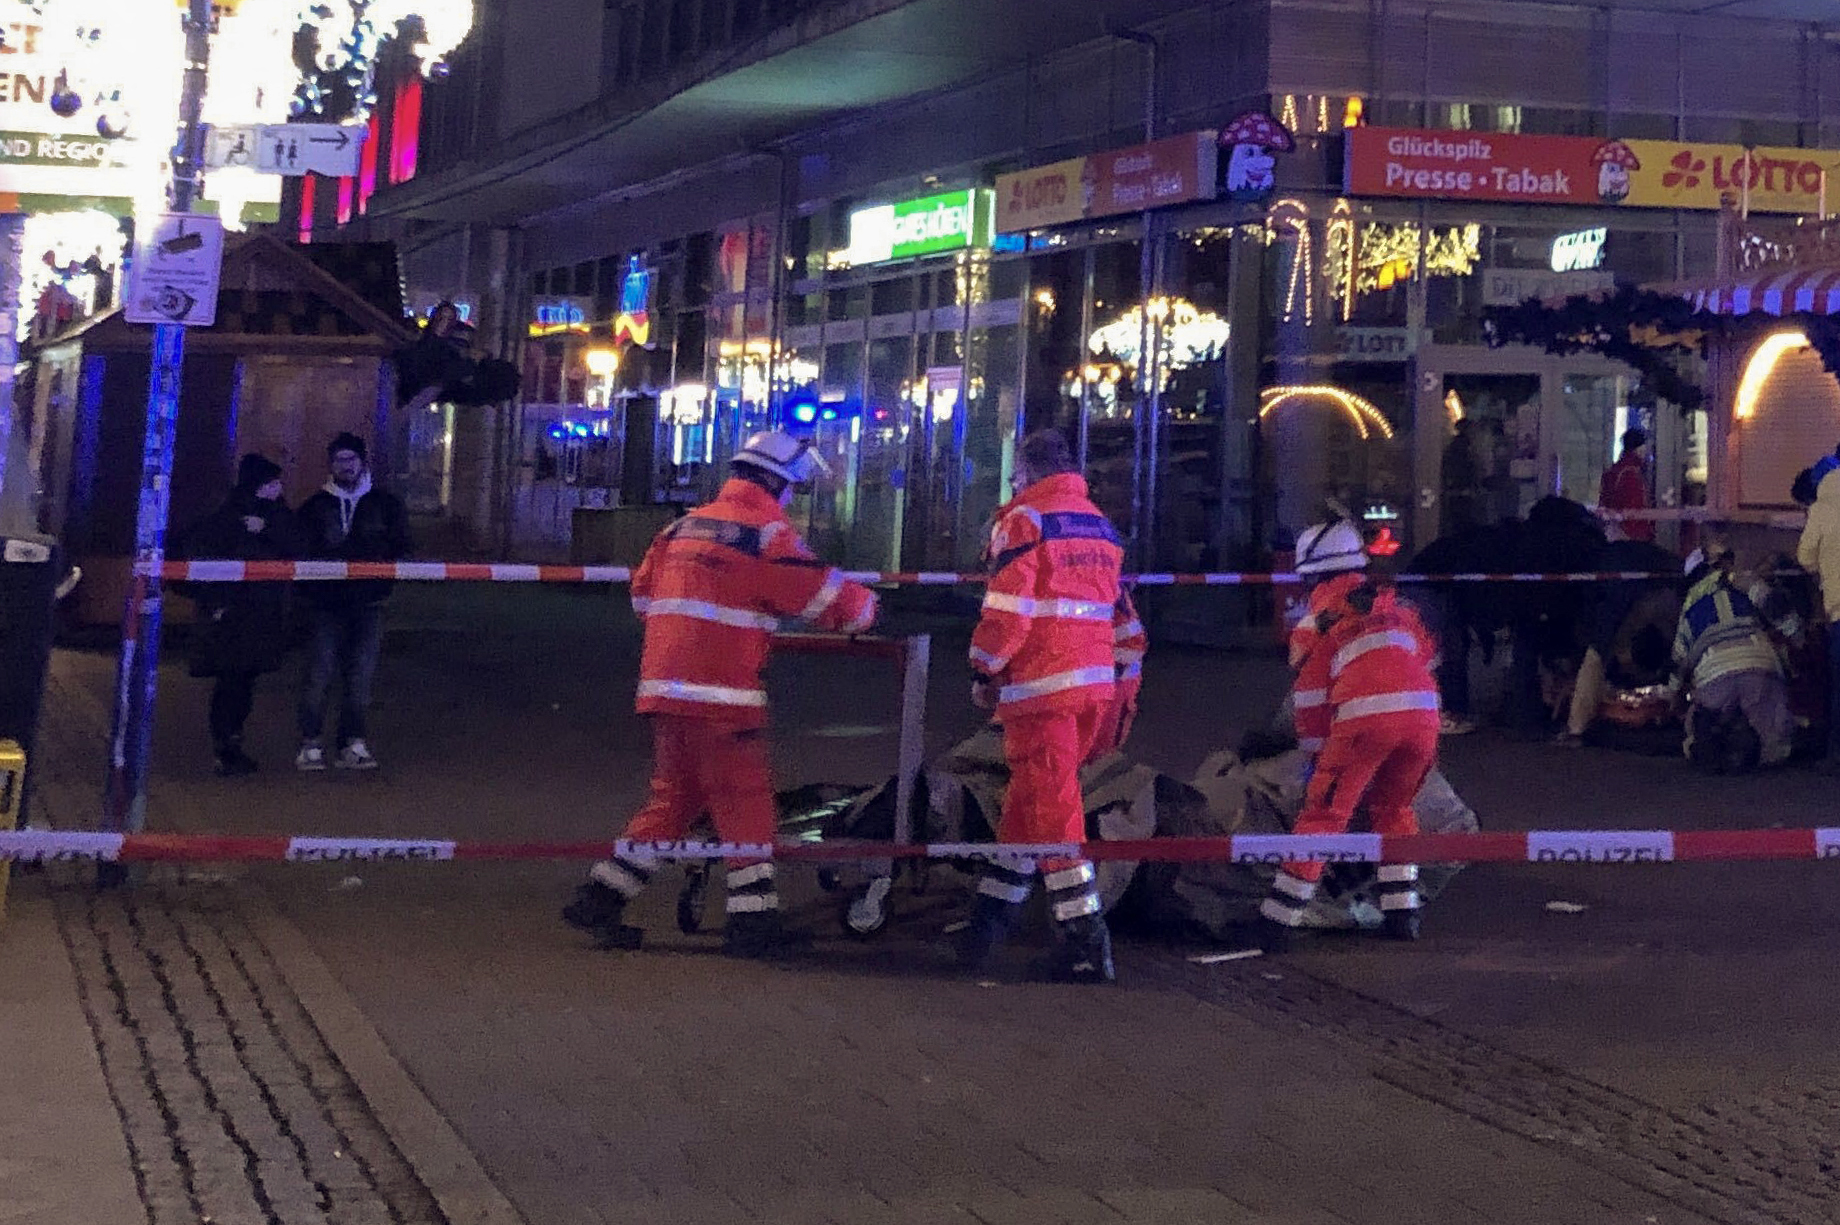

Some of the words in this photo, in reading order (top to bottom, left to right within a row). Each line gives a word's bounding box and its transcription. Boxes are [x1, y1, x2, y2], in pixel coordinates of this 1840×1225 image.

[1387, 135, 1493, 162] Glückspilz
[1386, 162, 1473, 191] Presse
[1491, 167, 1571, 195] Tabak
[1712, 154, 1825, 195] LOTTO
